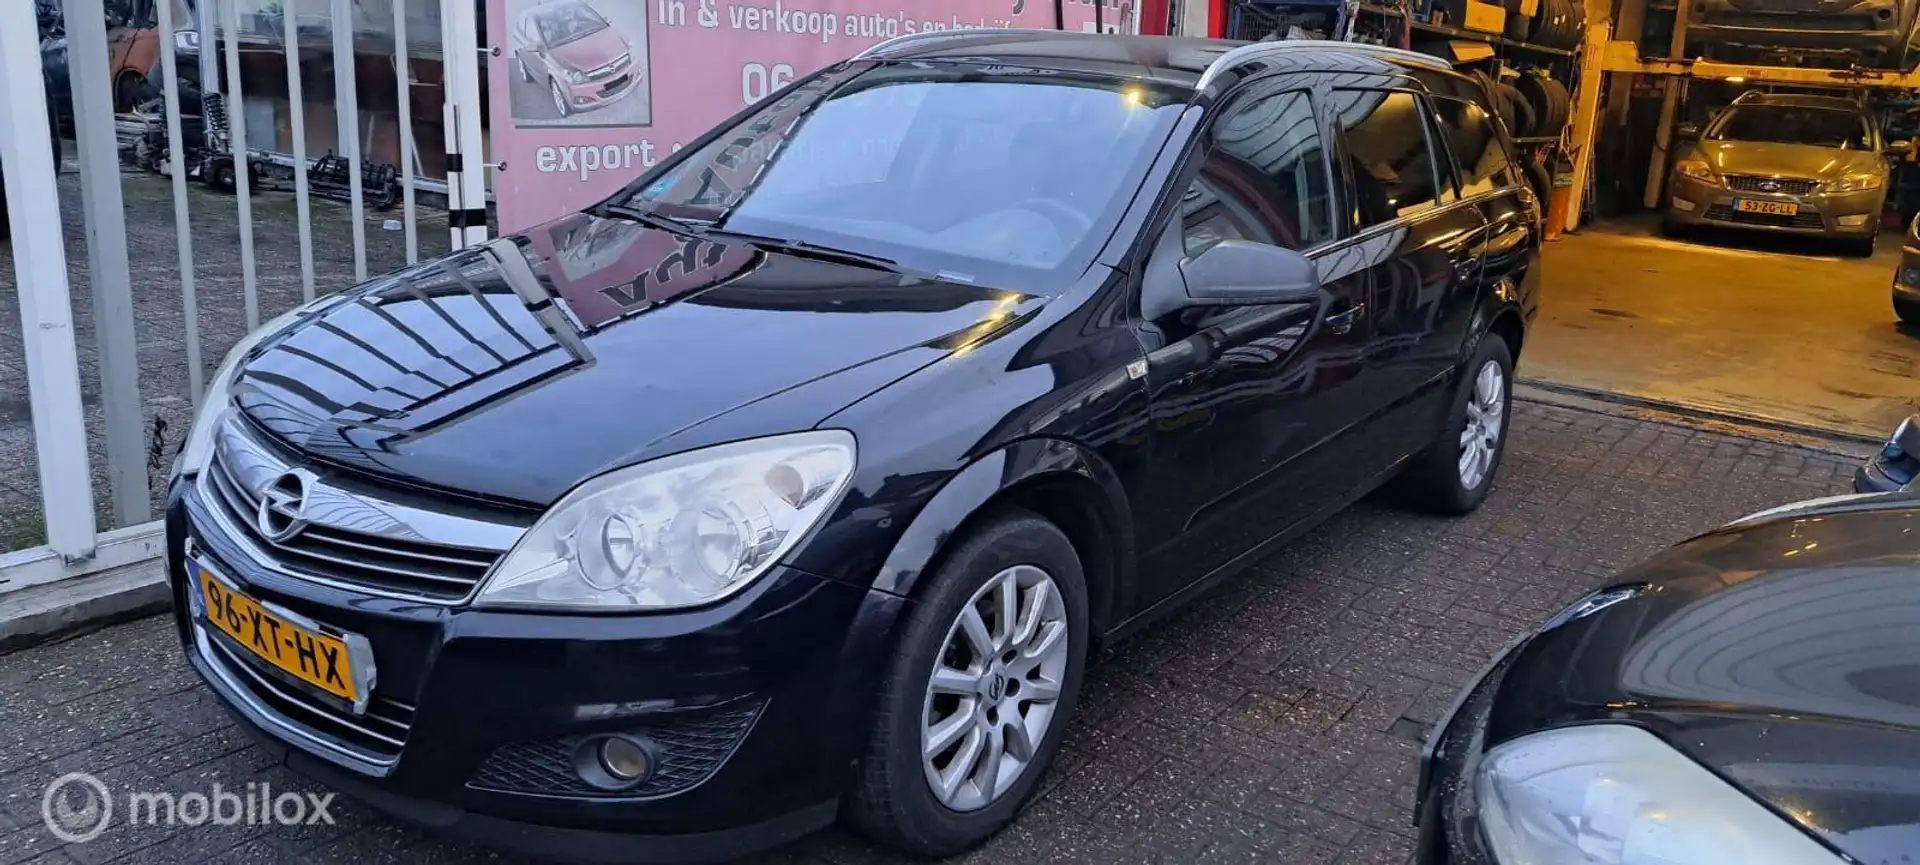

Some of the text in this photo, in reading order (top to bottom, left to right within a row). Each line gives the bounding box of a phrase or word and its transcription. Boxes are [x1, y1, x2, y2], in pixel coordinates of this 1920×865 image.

[697, 0, 719, 28] &
[728, 0, 837, 43] verkoop
[844, 10, 917, 38] auto's
[742, 62, 794, 106] 06
[536, 139, 656, 181] export
[207, 579, 347, 690] 96-XT-HX
